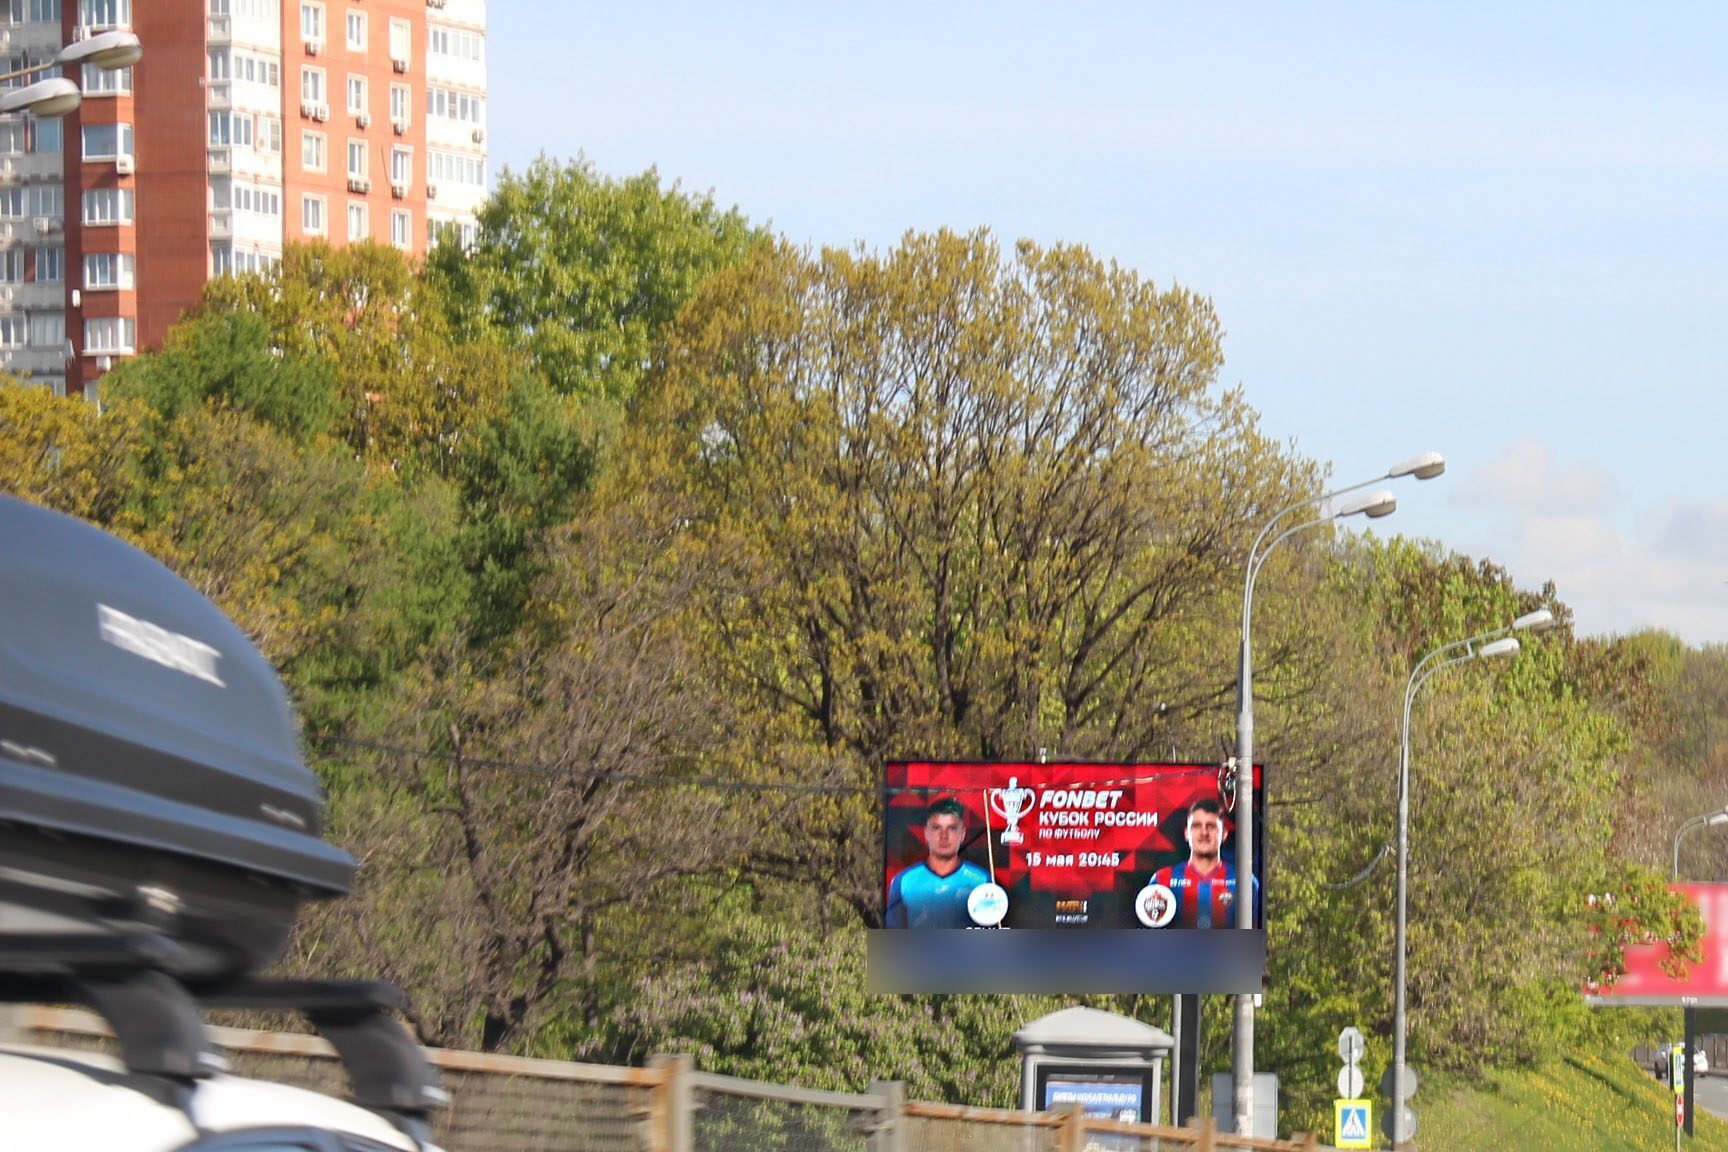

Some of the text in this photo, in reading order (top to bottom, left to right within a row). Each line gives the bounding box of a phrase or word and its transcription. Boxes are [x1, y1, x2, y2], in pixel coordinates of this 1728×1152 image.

[1040, 790, 1123, 809] FONBET
[1039, 811, 1158, 827] КУБОК РОССИИ
[1039, 828, 1100, 839] ПО ФУТБОЛУ
[1026, 852, 1120, 867] 15 мая 20:45
